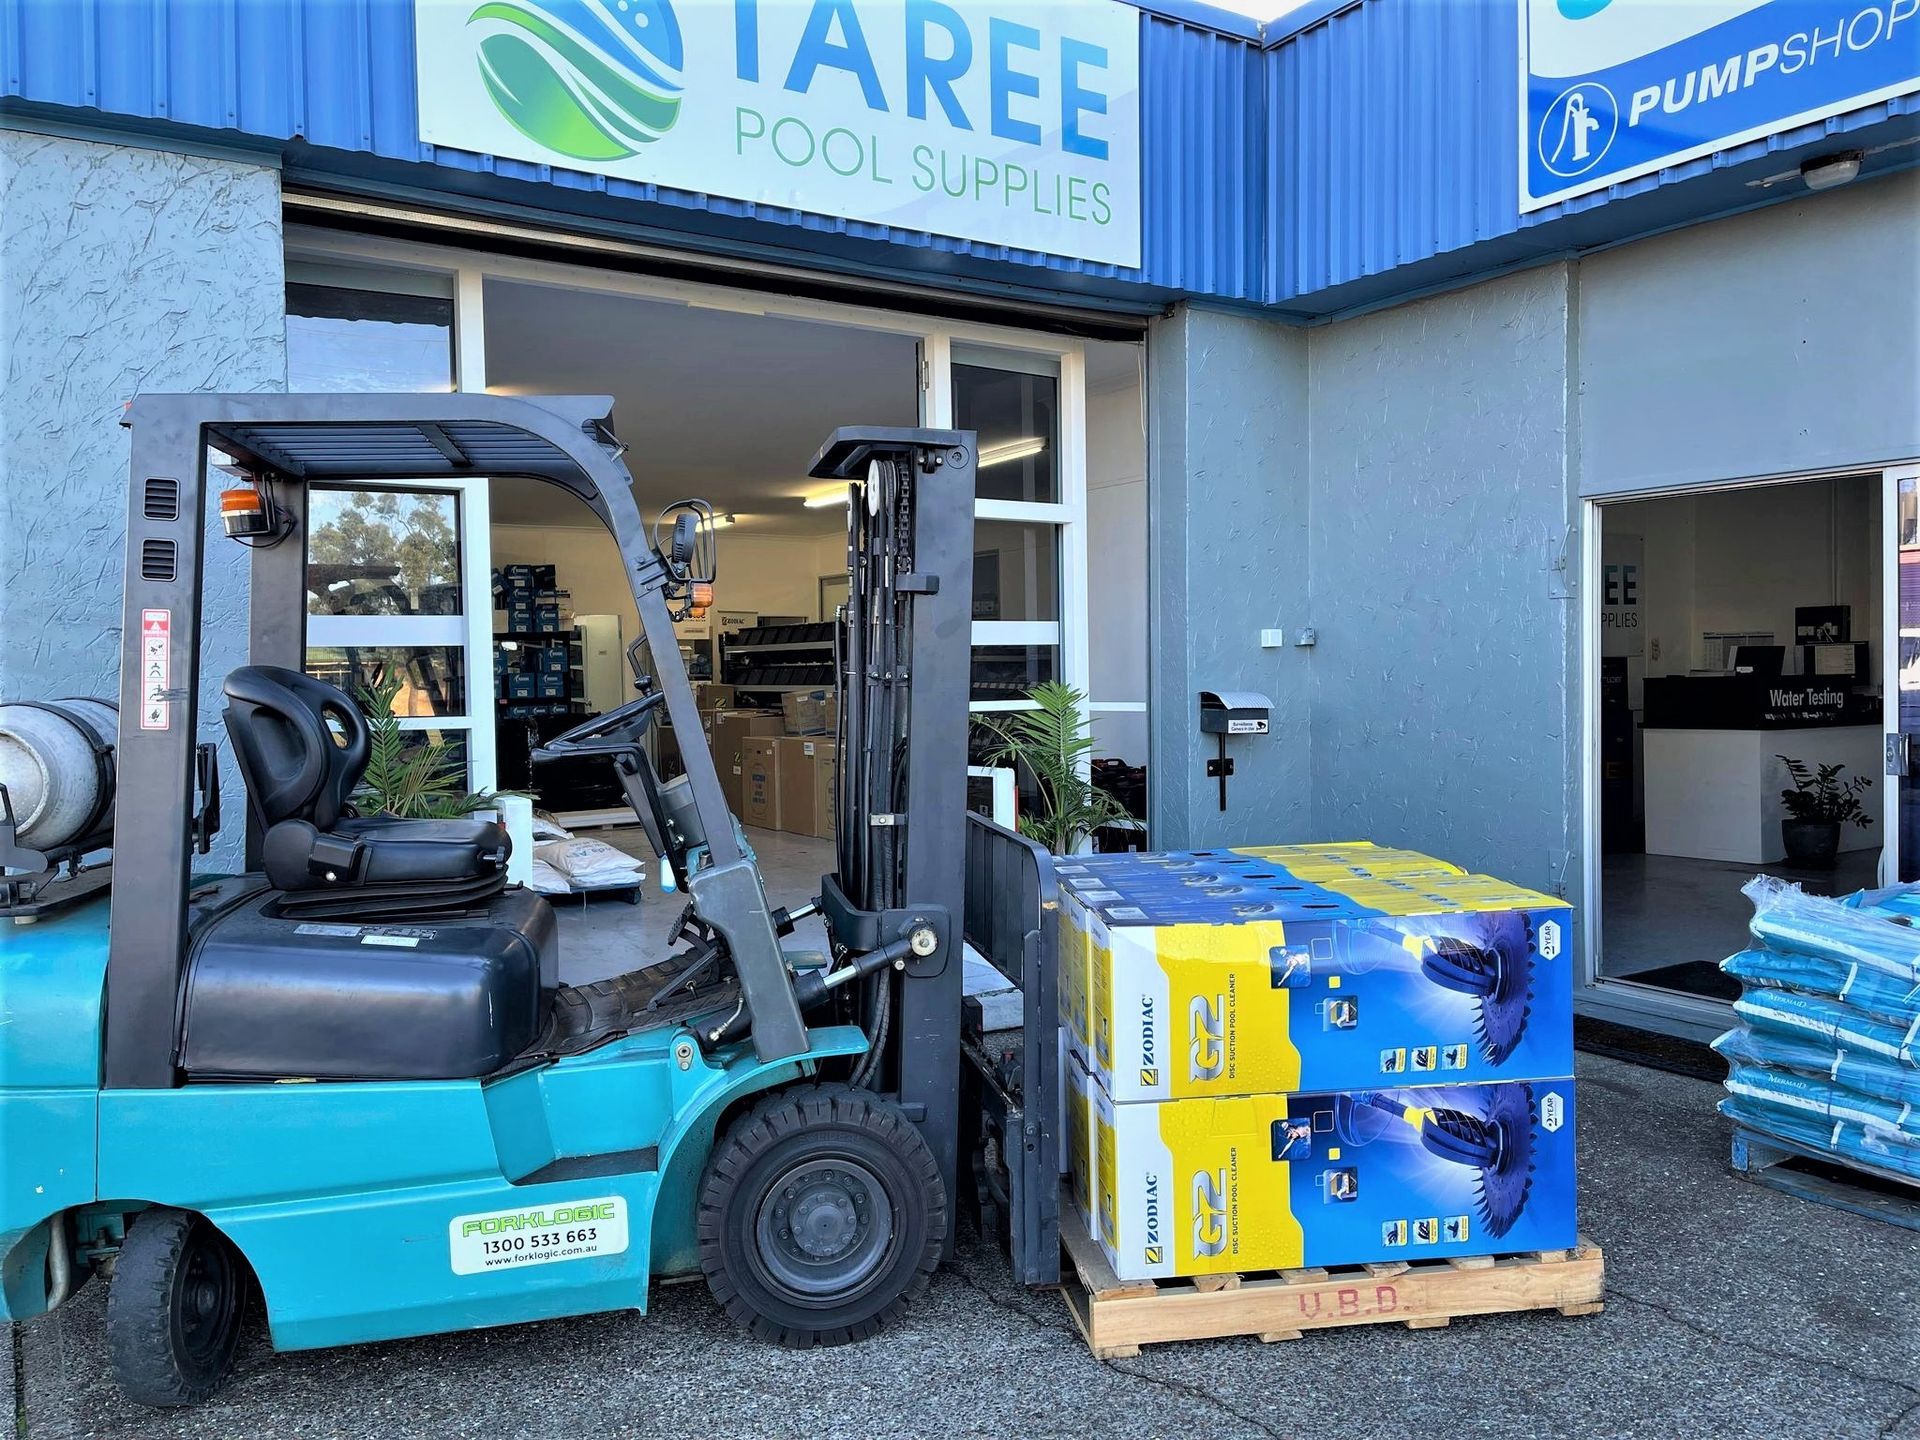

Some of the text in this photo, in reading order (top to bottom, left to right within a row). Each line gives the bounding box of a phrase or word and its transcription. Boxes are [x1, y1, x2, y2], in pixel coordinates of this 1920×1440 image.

[737, 106, 1112, 226] POOL SUPPLIES
[1769, 687, 1844, 708] Water Testing
[1544, 925, 1552, 946] YEAR
[1142, 997, 1154, 1066] ZODIAC
[1189, 993, 1225, 1084] G2
[1230, 1147, 1238, 1181] CLEANER
[462, 1202, 615, 1238] FORKLOGIC
[1145, 1174, 1159, 1244] ZODIAC
[1192, 1167, 1229, 1261] G2
[483, 1227, 597, 1255] 1300 533 663
[485, 1244, 598, 1267] www.forklogic.com.au
